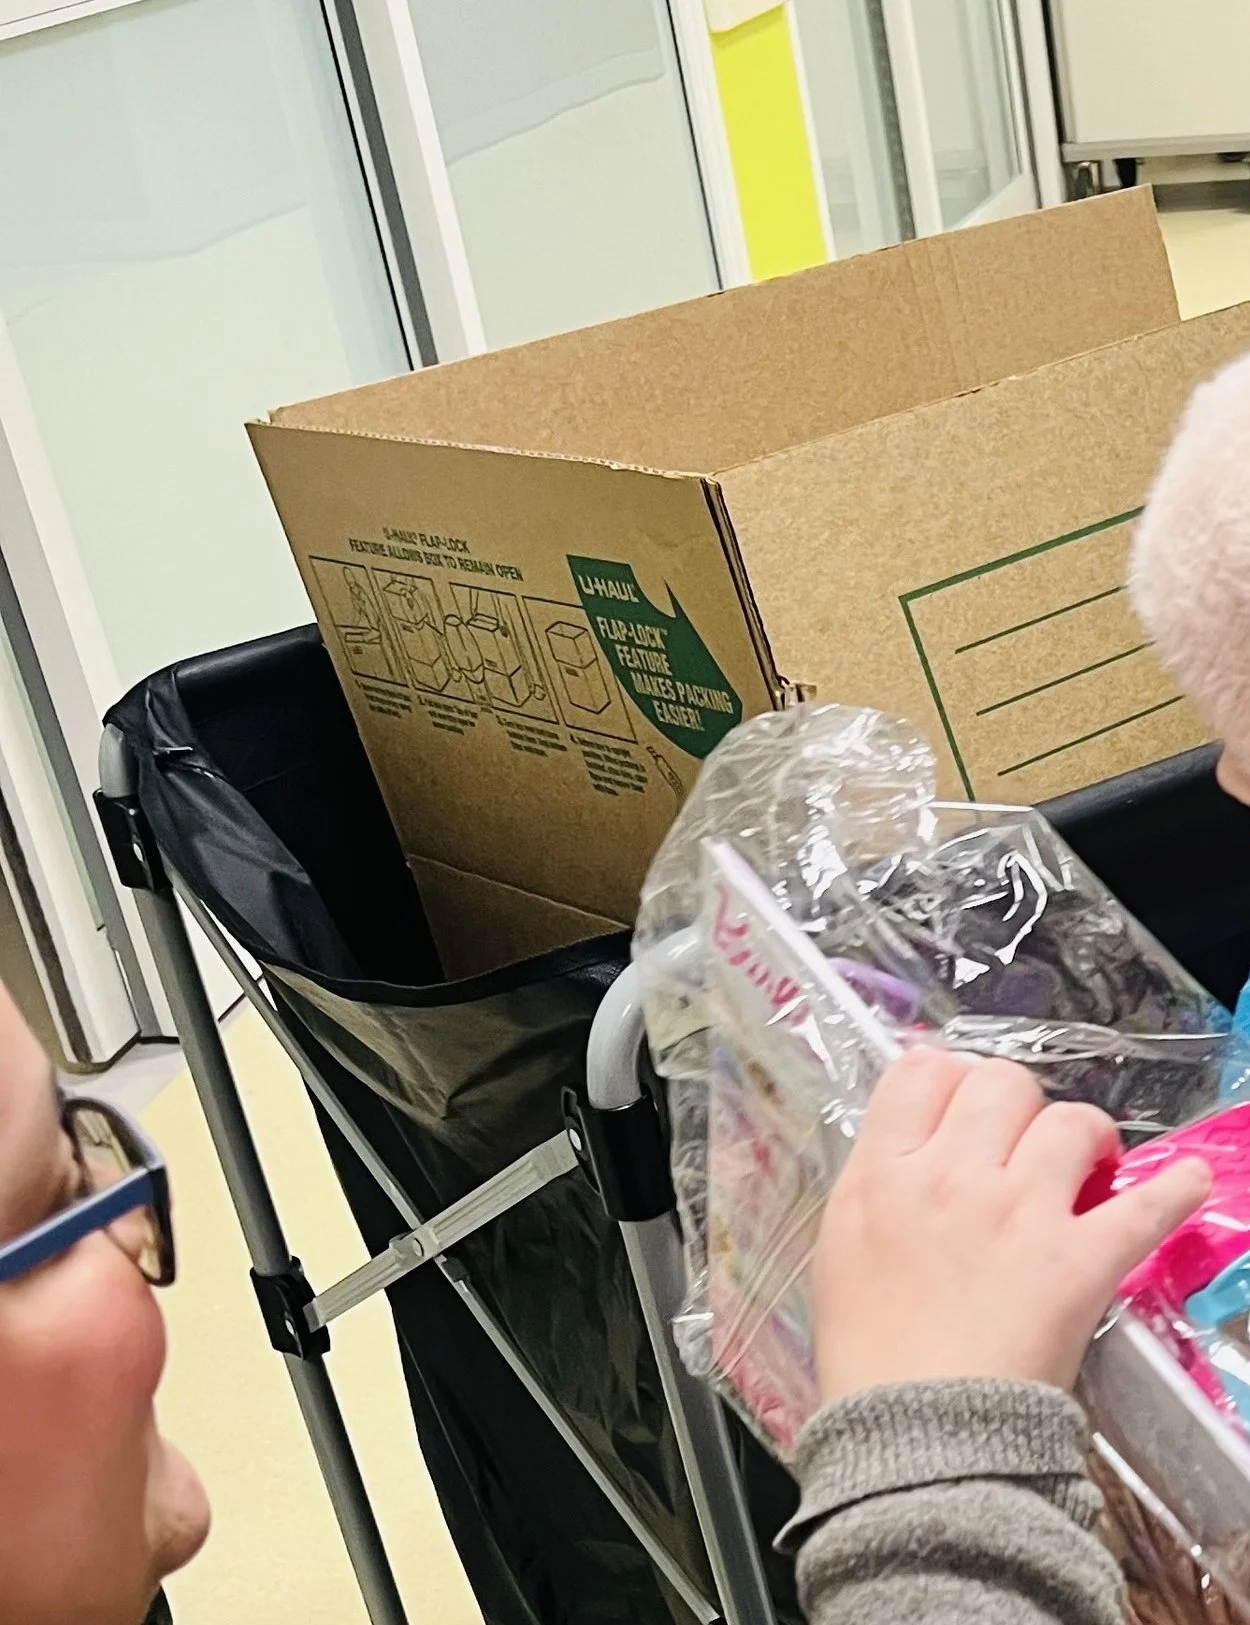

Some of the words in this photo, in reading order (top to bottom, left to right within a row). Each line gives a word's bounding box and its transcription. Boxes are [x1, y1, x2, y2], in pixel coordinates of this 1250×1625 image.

[348, 538, 389, 557] FEATURE
[443, 555, 457, 569] TO
[457, 557, 496, 576] REMAIN
[496, 563, 524, 581] OPEN
[578, 575, 640, 603] U-HAUL
[596, 616, 667, 650] FLAP-LOCK
[615, 644, 673, 676] FEATURE
[630, 671, 677, 701] MAKES
[675, 681, 734, 715] PACKING
[653, 700, 705, 732] EASIER!
